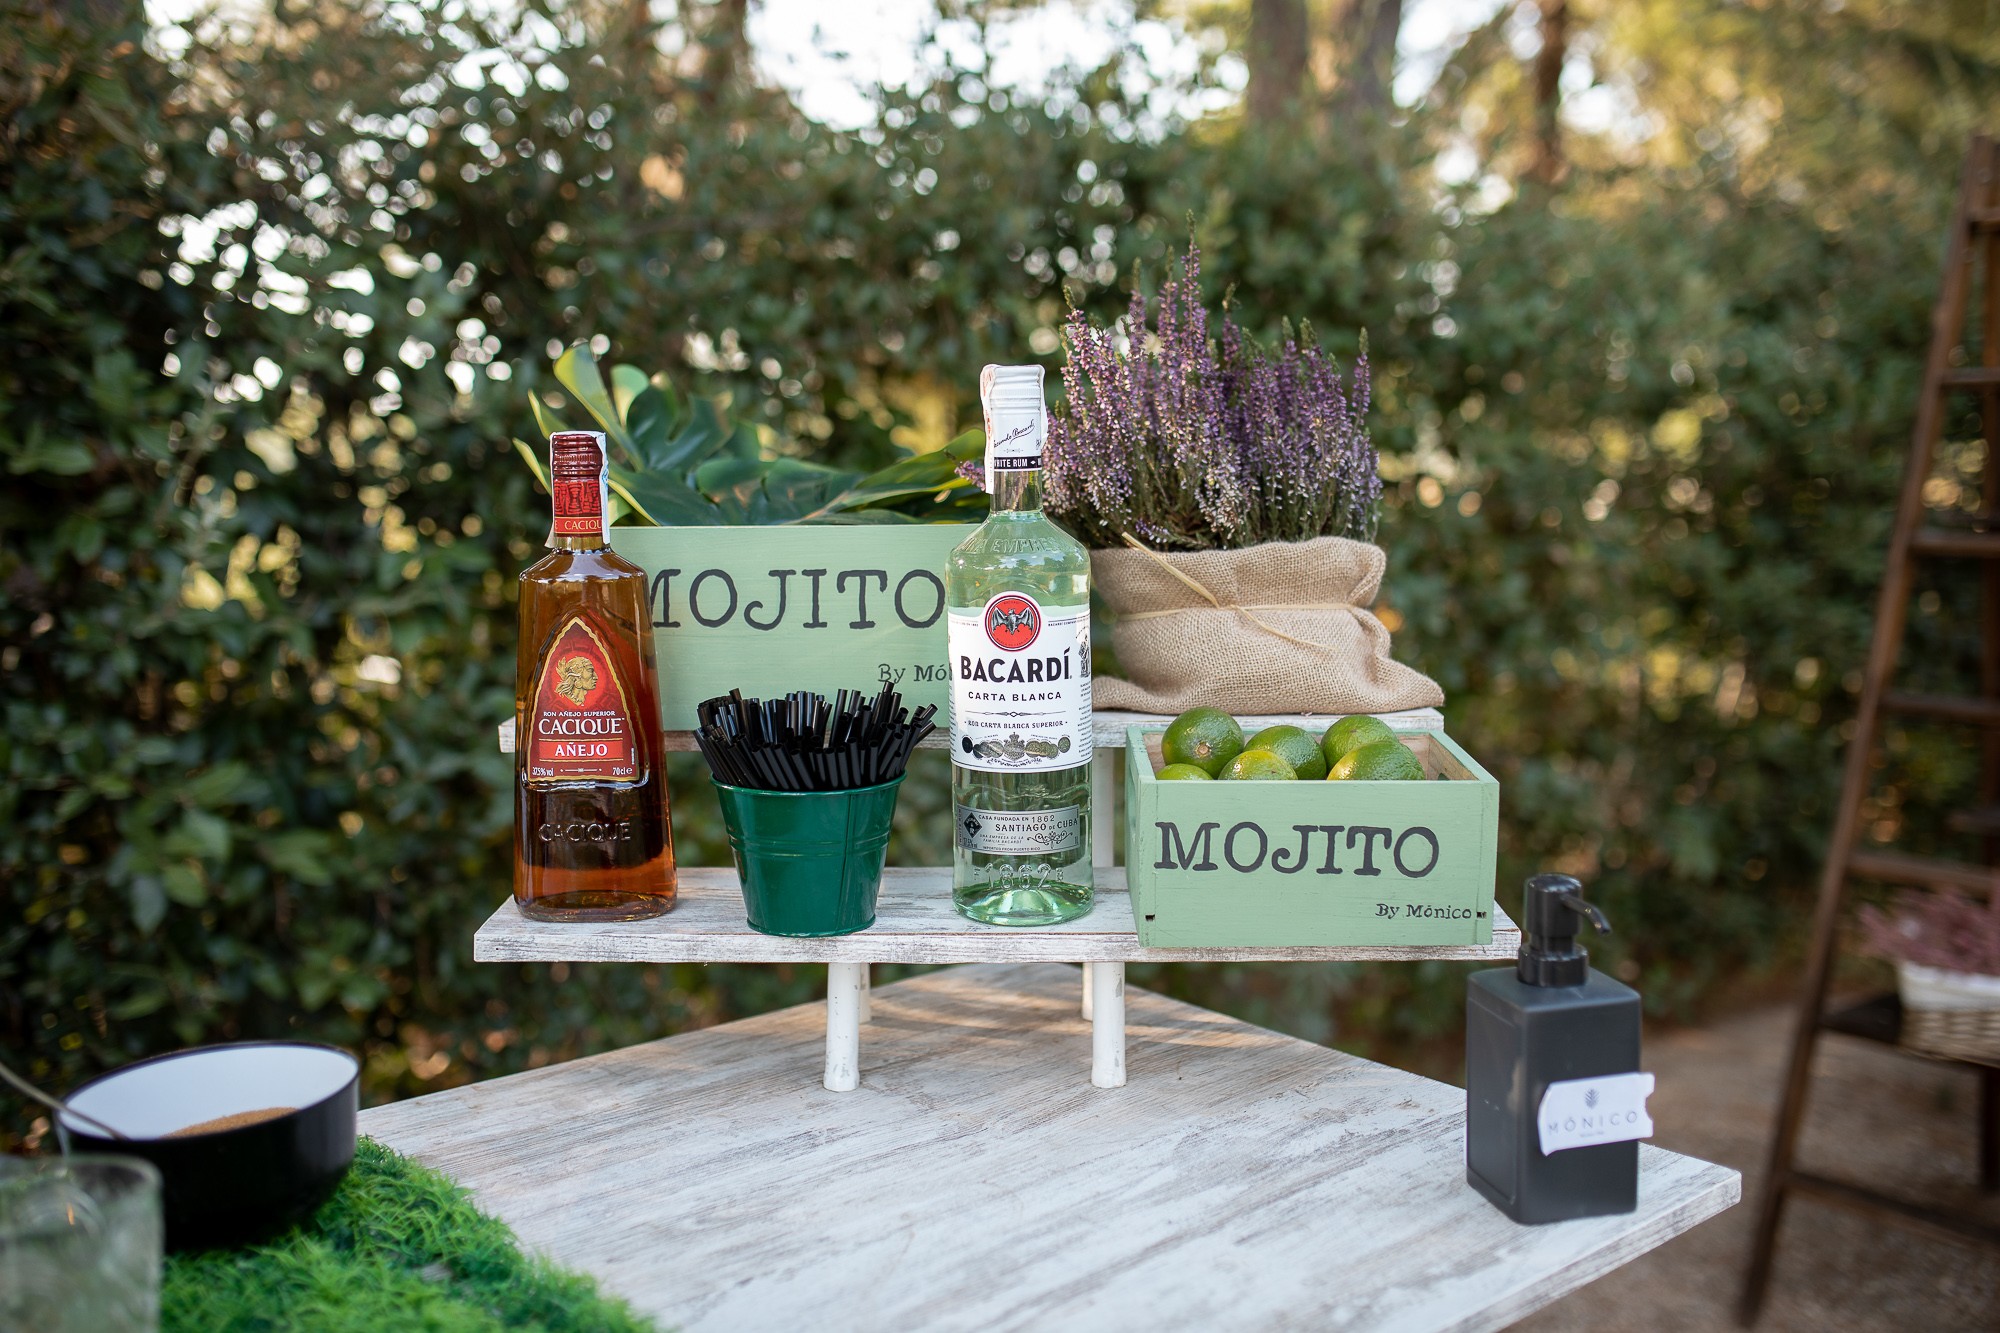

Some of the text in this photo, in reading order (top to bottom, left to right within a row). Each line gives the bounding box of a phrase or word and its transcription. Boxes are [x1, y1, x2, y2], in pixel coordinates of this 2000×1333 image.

[1013, 458, 1028, 468] RUM
[564, 519, 602, 530] CACIQU
[960, 646, 1071, 683] BACARDÍ
[877, 663, 906, 684] By
[968, 691, 1062, 702] CARTA BLANCA
[538, 717, 623, 735] CACIQUE
[981, 721, 1002, 730] CARTA
[1004, 722, 1030, 730] BLANCA
[1032, 719, 1064, 729] SUPERIOR
[554, 741, 608, 757] AÑEJO
[995, 823, 1047, 832] SANTIAGO
[1056, 817, 1078, 829] CUBA
[1031, 814, 1055, 824] 1862
[1153, 821, 1440, 878] MOJITO
[1375, 903, 1473, 920] By Mónico
[1548, 1110, 1638, 1135] MÓNICO
